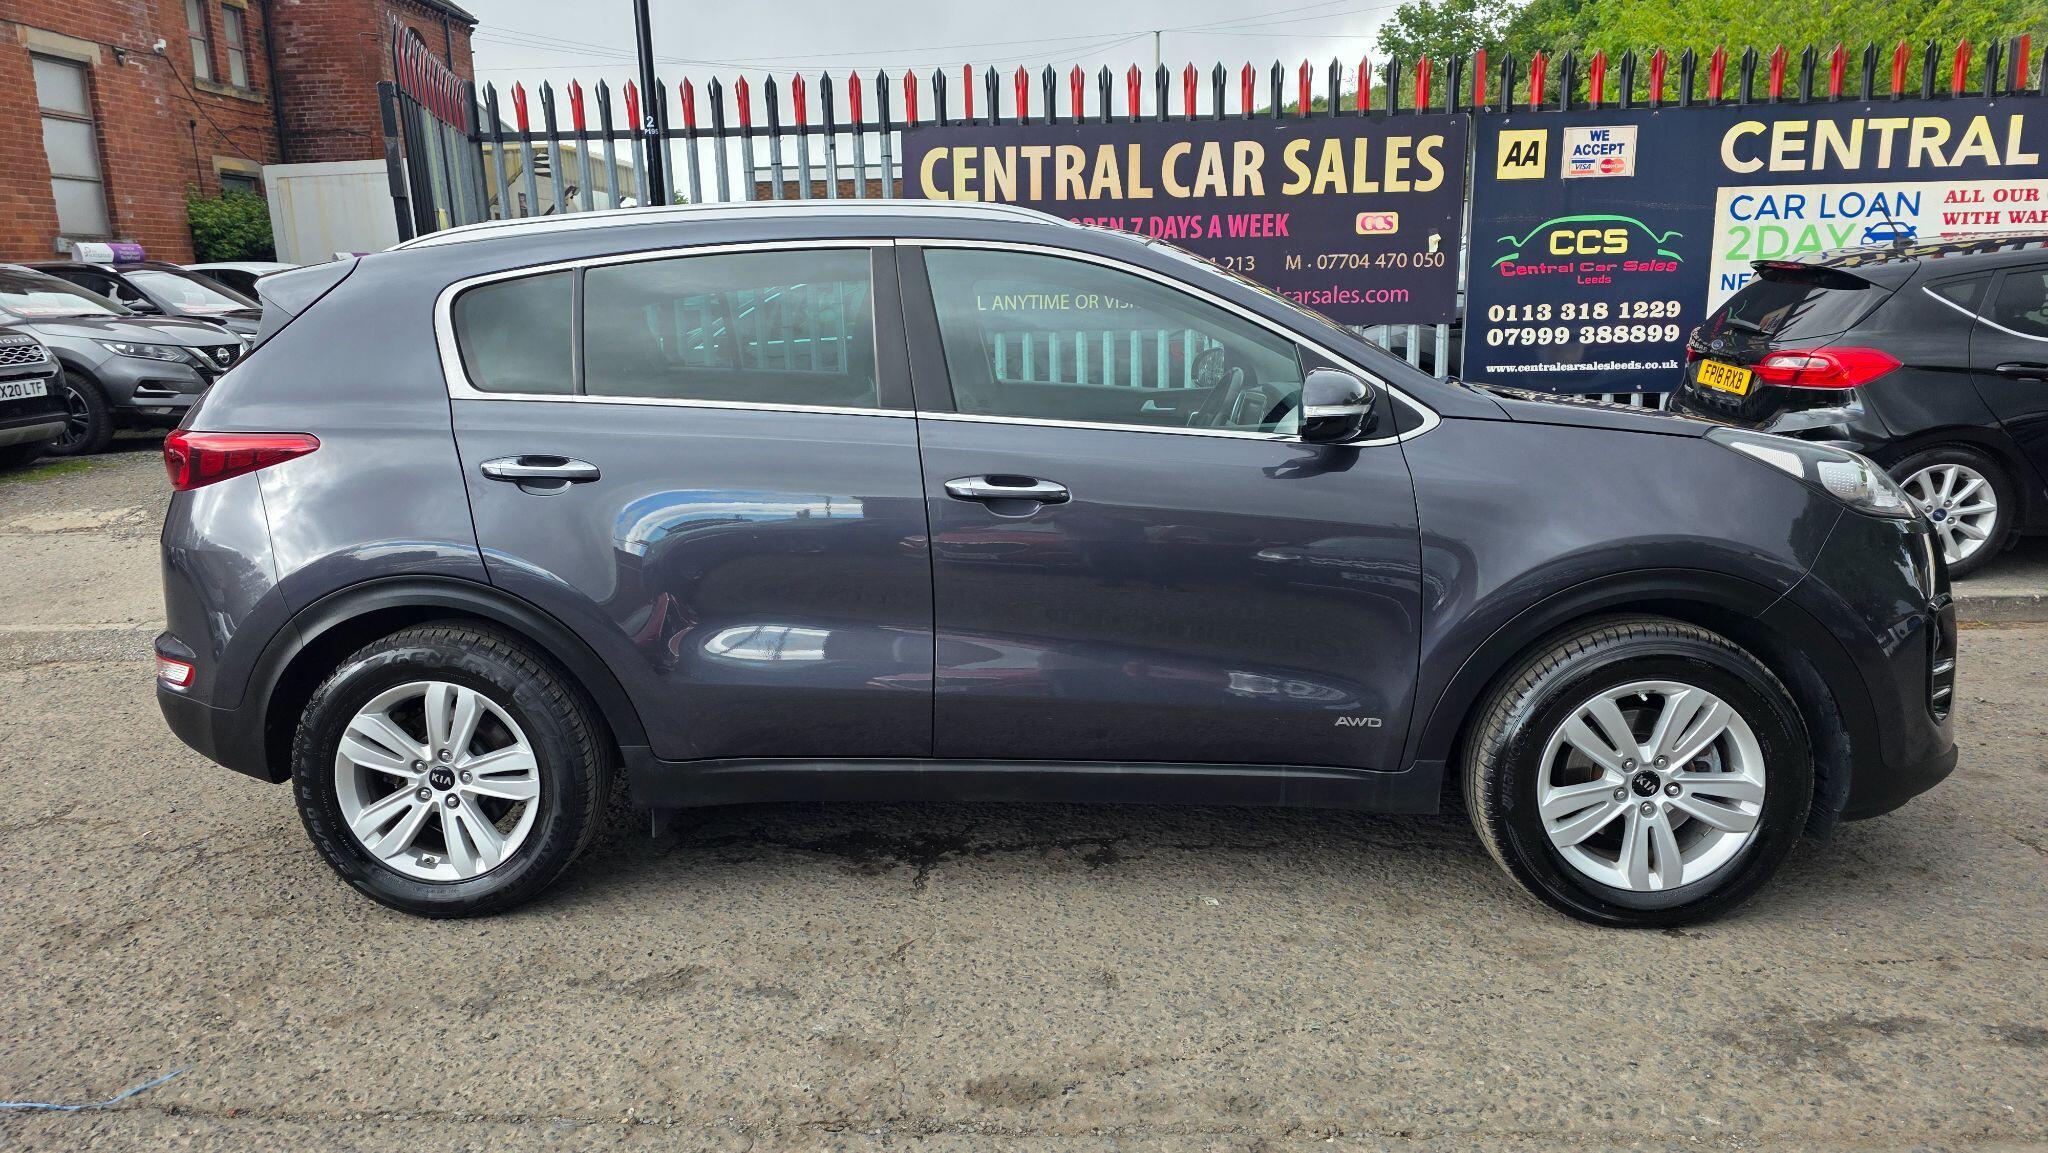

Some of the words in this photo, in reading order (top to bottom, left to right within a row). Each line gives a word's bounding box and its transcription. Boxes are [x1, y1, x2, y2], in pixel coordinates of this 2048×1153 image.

[646, 115, 655, 128] 2
[1590, 130, 1610, 142] WE
[1721, 114, 2040, 174] CENTRAL
[1503, 140, 1540, 167] AA
[1573, 143, 1625, 156] ACCEPT
[920, 143, 1154, 202] CENTRAL
[1161, 140, 1265, 198] CAR
[1282, 135, 1445, 196] SALES
[1943, 189, 1985, 204] ALL
[1993, 188, 2040, 203] OUR
[1730, 194, 1806, 221] CAR
[1820, 191, 1921, 219] LOAN
[1149, 215, 1203, 240] DAYS
[1207, 215, 1223, 239] A
[1228, 213, 1290, 238] WEEK
[1943, 211, 2001, 226] WITH
[1549, 228, 1628, 255] CCS
[1725, 223, 1858, 261] 2DAY
[1317, 253, 1371, 270] 07704
[1375, 253, 1408, 269] 470
[1413, 252, 1445, 268] 050
[1500, 261, 1574, 277] Central
[1580, 262, 1618, 272] Car
[1623, 259, 1677, 273] Sales
[1577, 275, 1611, 284] Leeds
[992, 294, 1069, 310] ANYTIME
[1075, 294, 1099, 310] OR
[1488, 303, 1552, 322] 0113
[1561, 302, 1608, 321] 318
[1618, 300, 1681, 319] 1229
[1486, 326, 1570, 347] 07999
[1579, 324, 1680, 345] 388899
[1486, 360, 1679, 373] www.centralcarsalesleeds.co.uk
[1703, 364, 1724, 384] FP18
[23, 382, 42, 396] LTF
[1334, 716, 1382, 728] AWD
[431, 772, 452, 786] KIA
[1635, 774, 1657, 794] KIA
